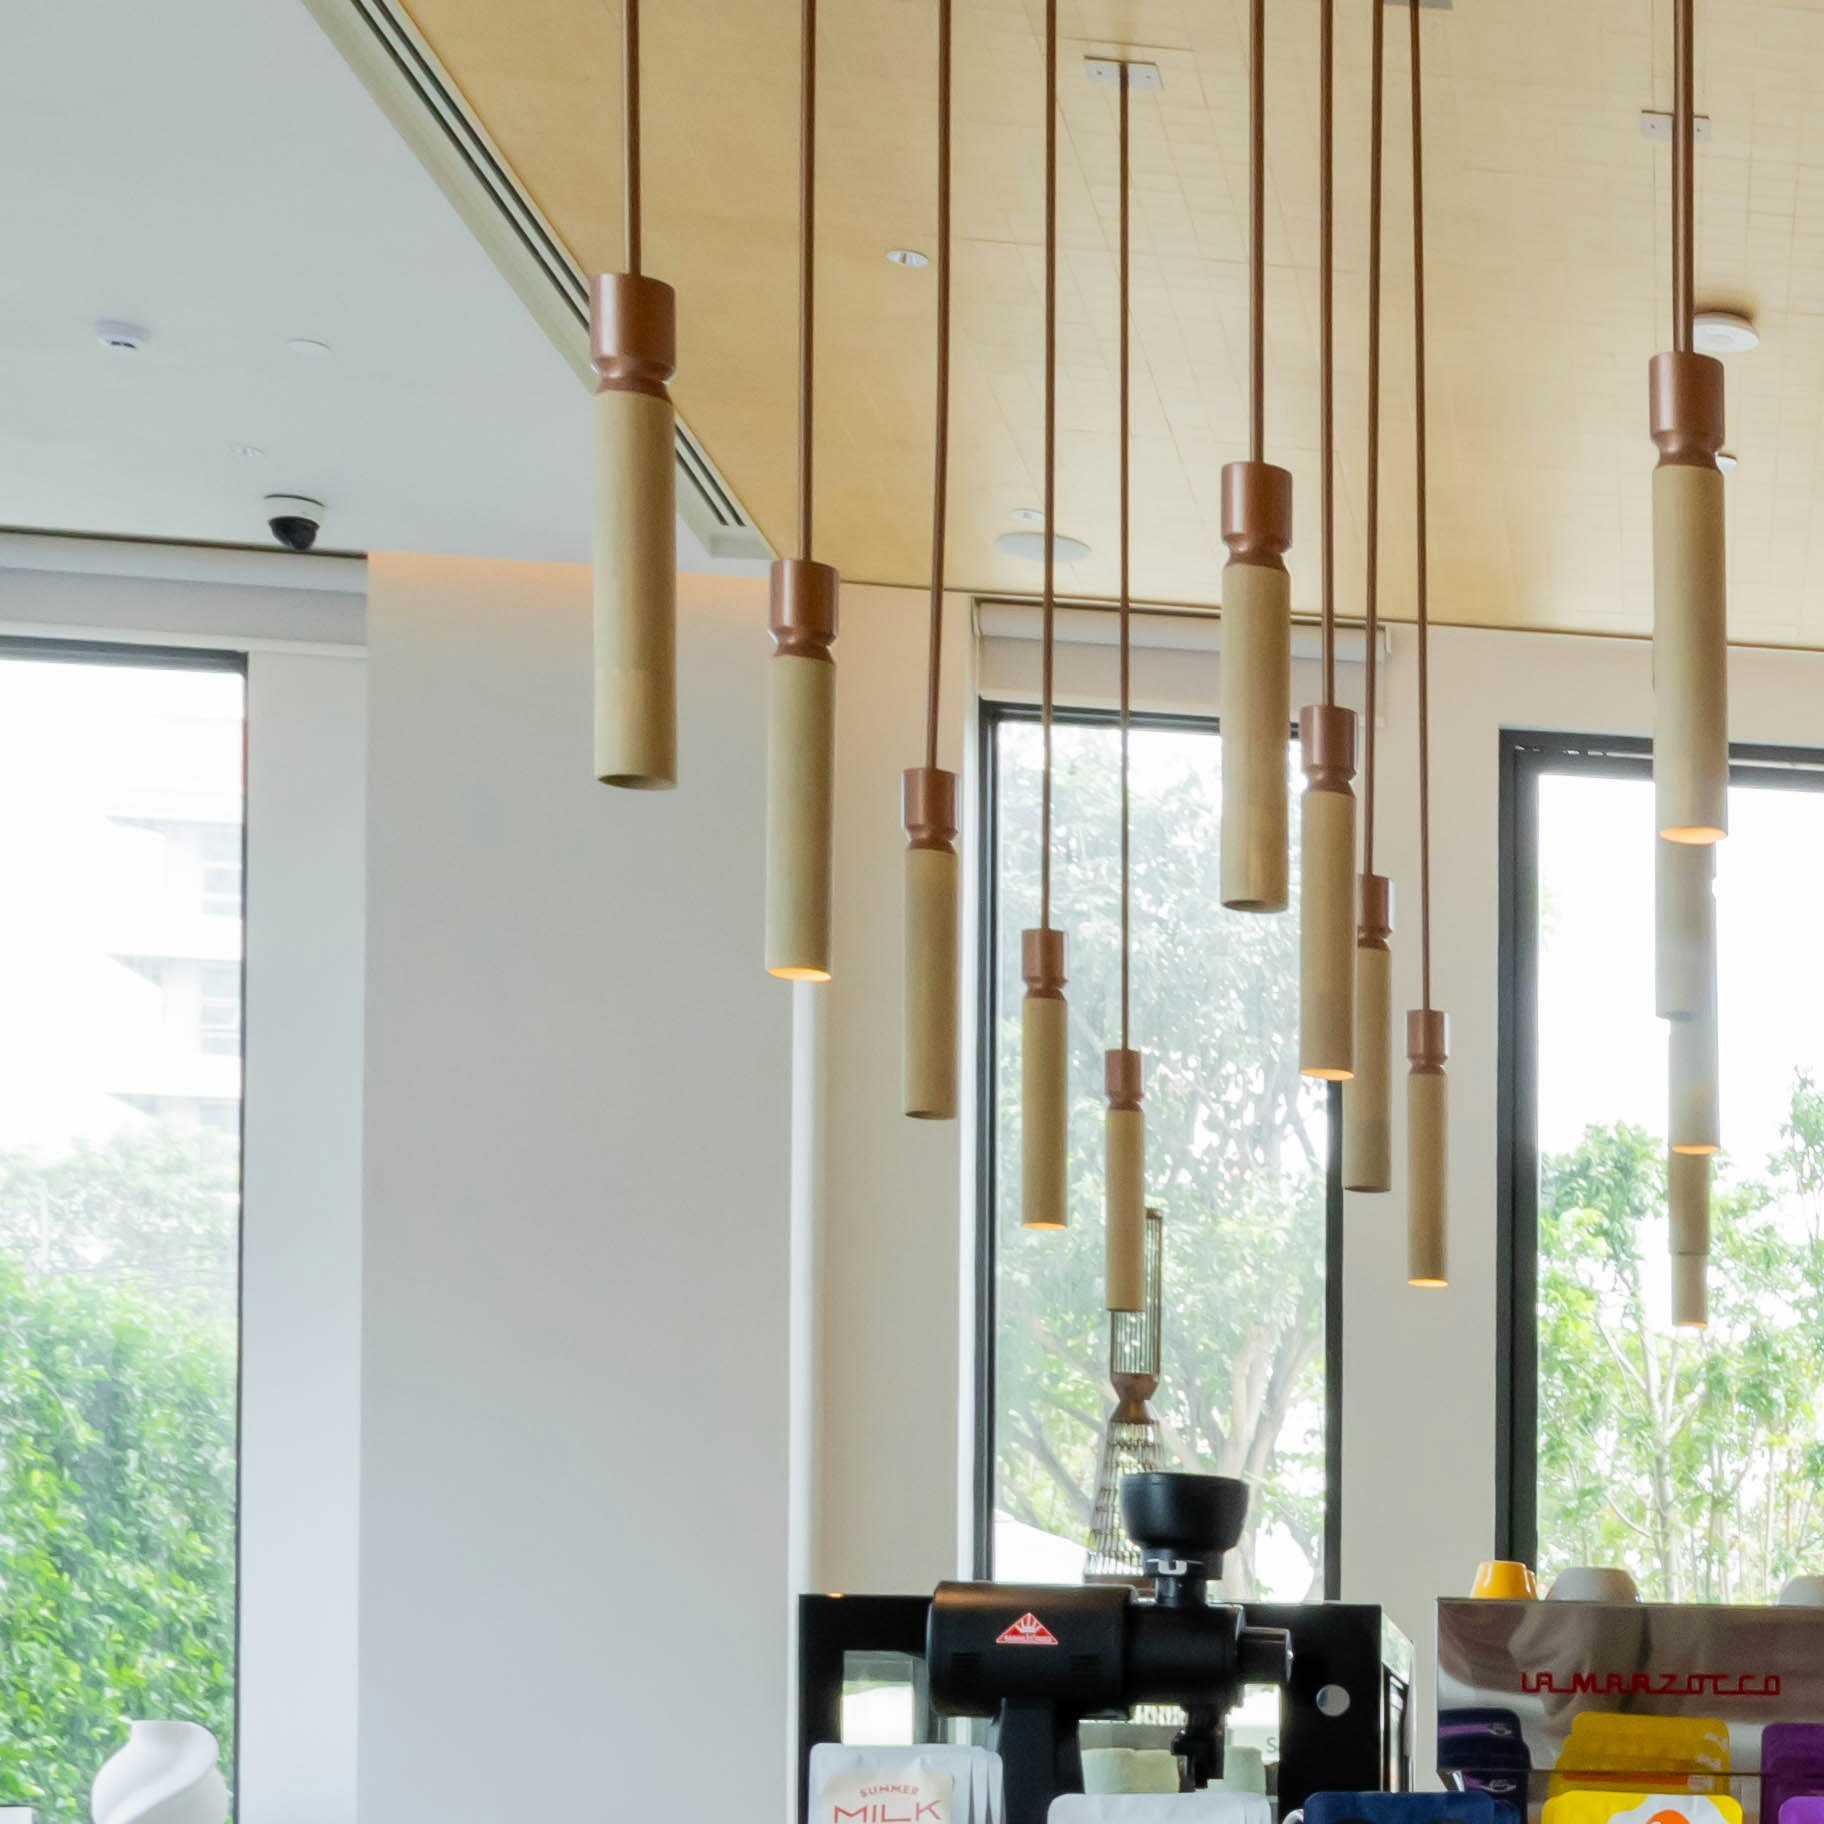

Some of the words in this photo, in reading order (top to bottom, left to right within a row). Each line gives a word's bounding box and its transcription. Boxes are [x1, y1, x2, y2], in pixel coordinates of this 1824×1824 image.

[1573, 1672, 1782, 1696] MARZOCCO
[859, 1785, 919, 1798] SUMMER
[833, 1800, 942, 1824] MILK
